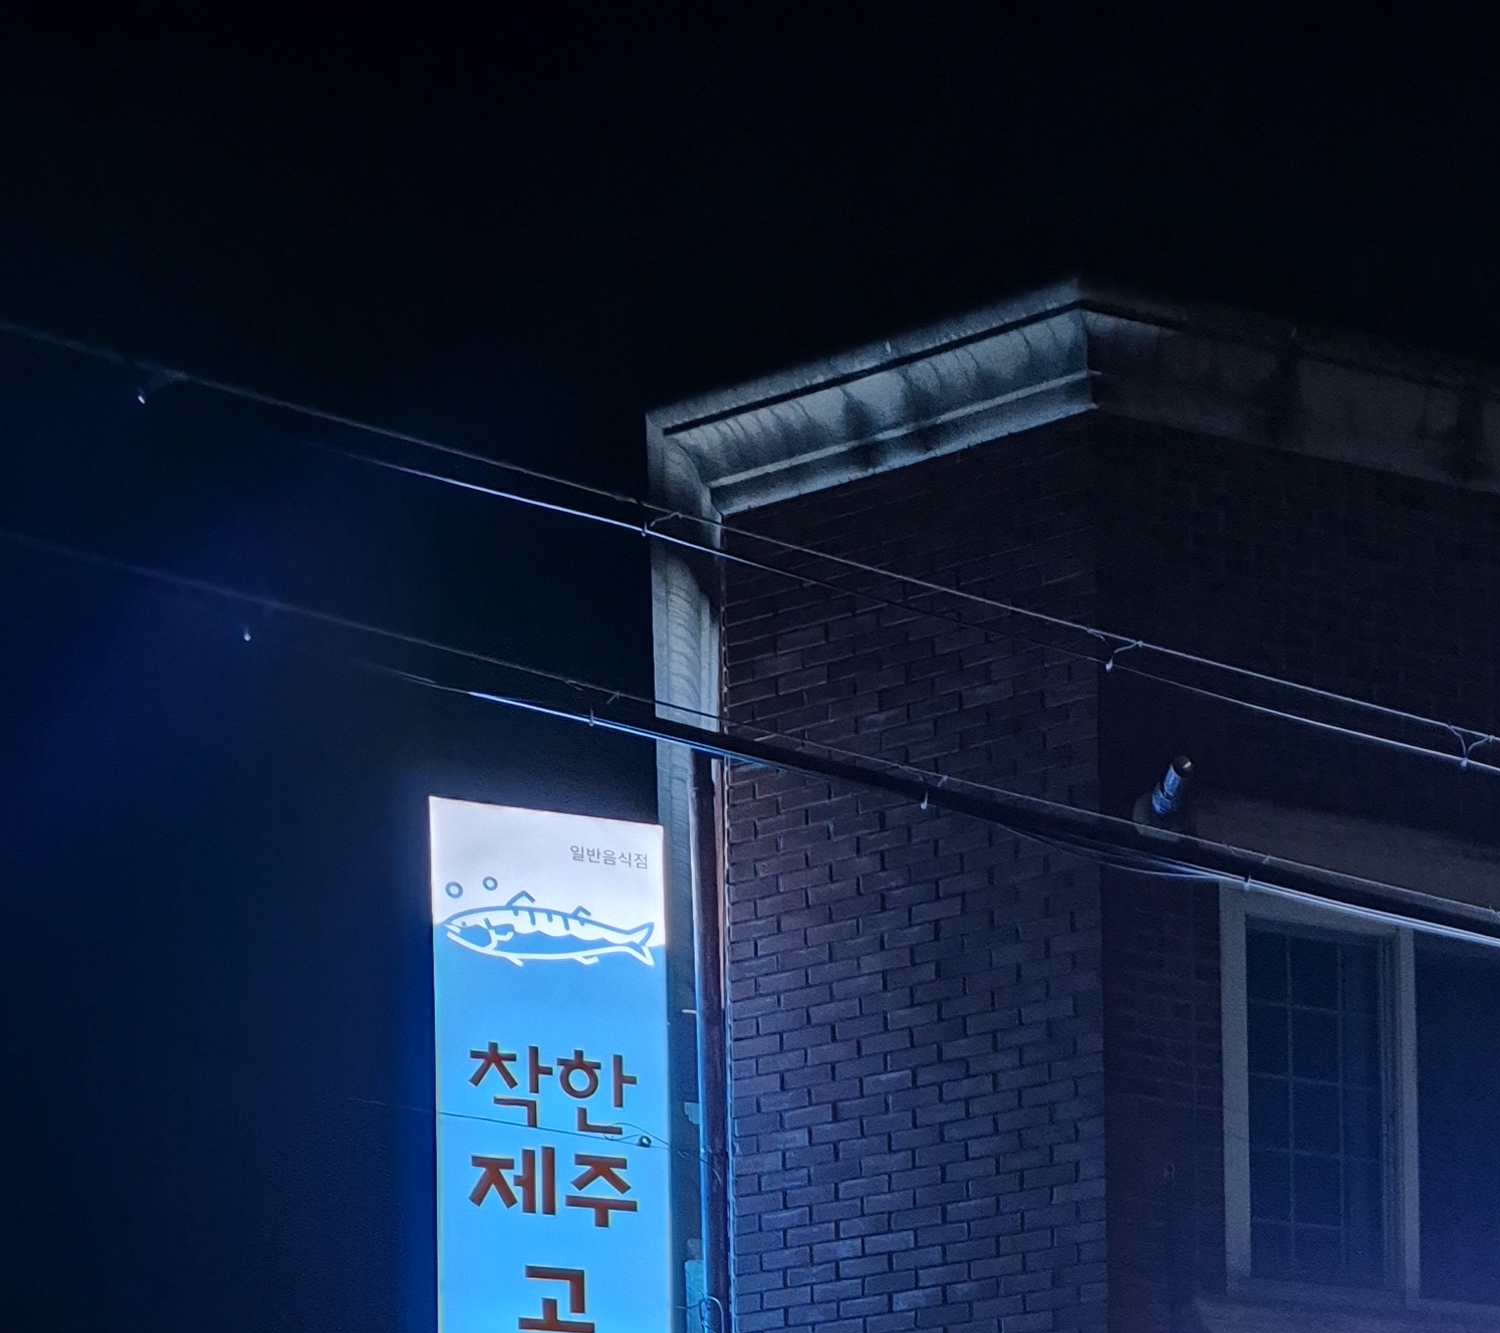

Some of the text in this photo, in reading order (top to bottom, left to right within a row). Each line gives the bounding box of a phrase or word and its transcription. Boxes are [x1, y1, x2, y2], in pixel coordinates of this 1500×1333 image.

[569, 844, 649, 870] 일반음식점
[469, 1040, 638, 1136] 착한
[468, 1145, 638, 1228] 제주
